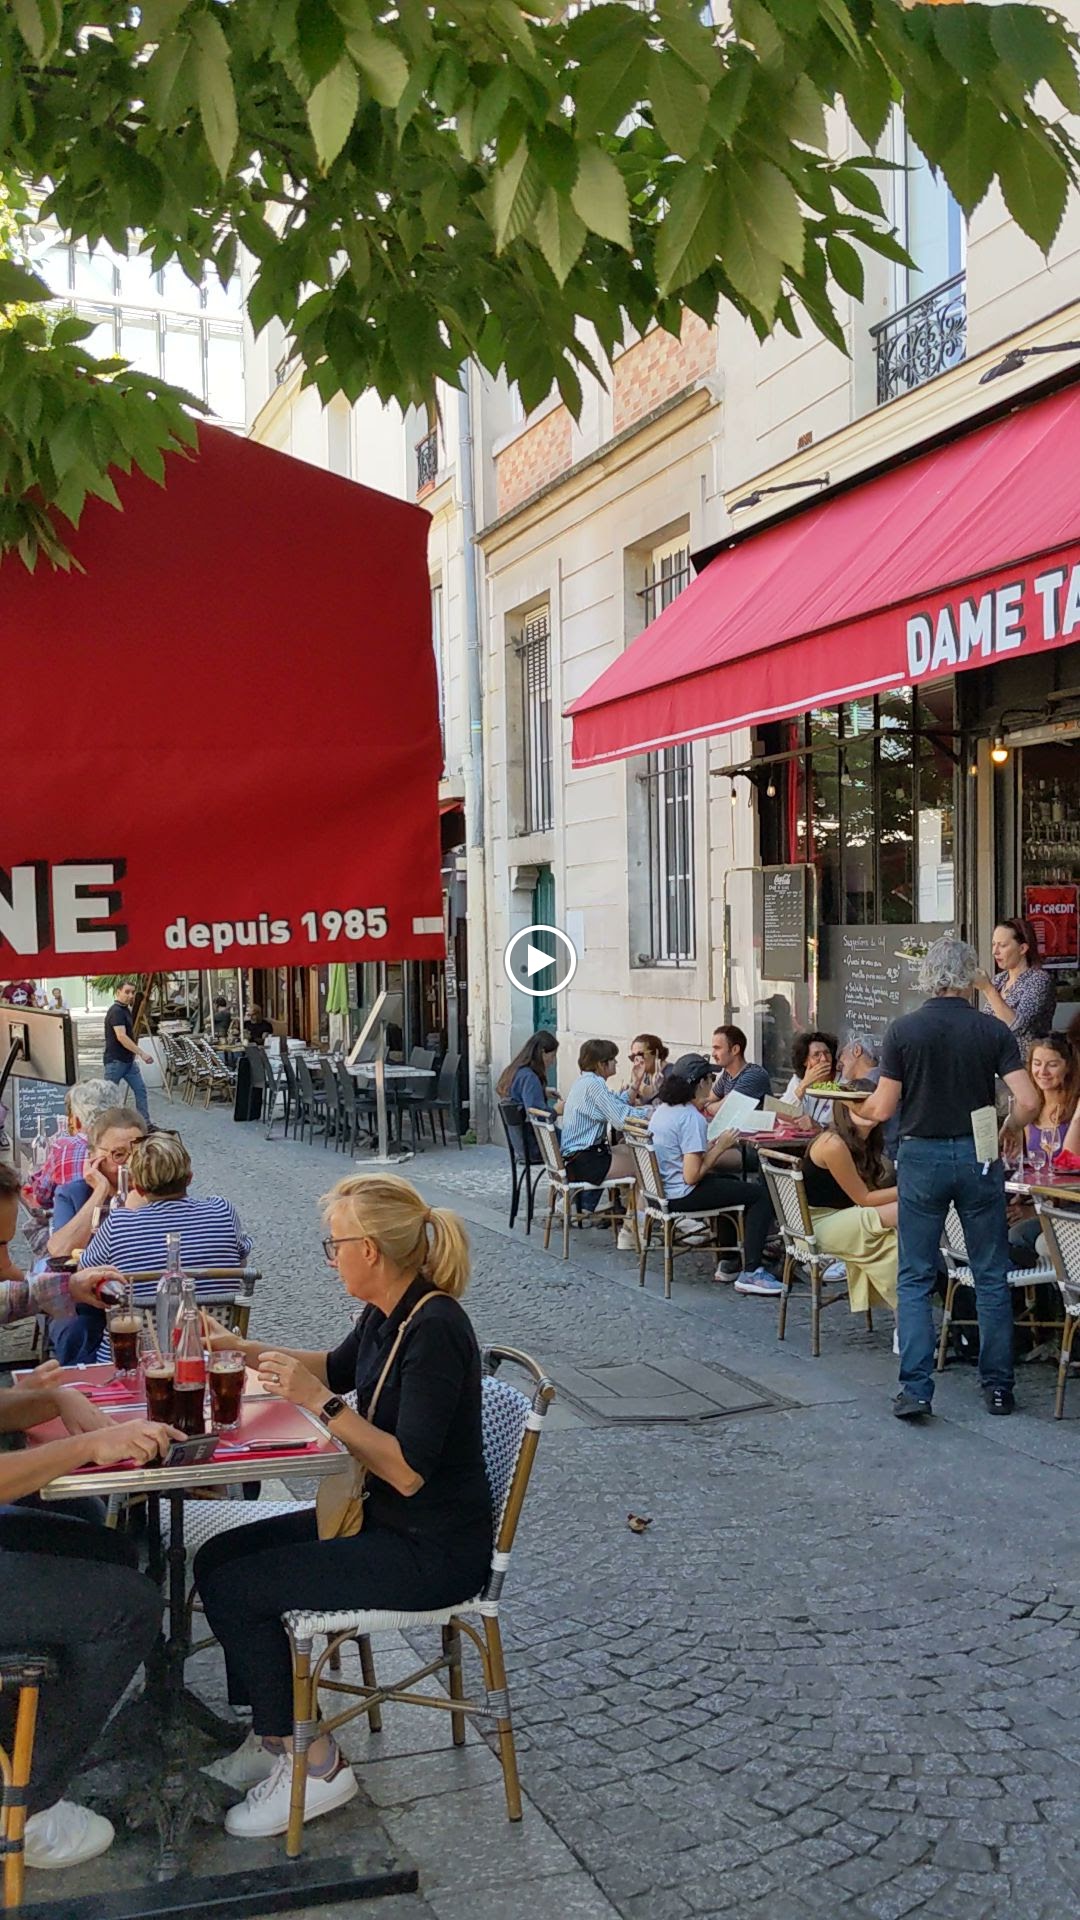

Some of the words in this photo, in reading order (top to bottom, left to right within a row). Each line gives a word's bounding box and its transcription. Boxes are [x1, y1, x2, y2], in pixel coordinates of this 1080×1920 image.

[907, 584, 1023, 677] DAME
[164, 913, 291, 954] depuis
[301, 907, 388, 943] 1985
